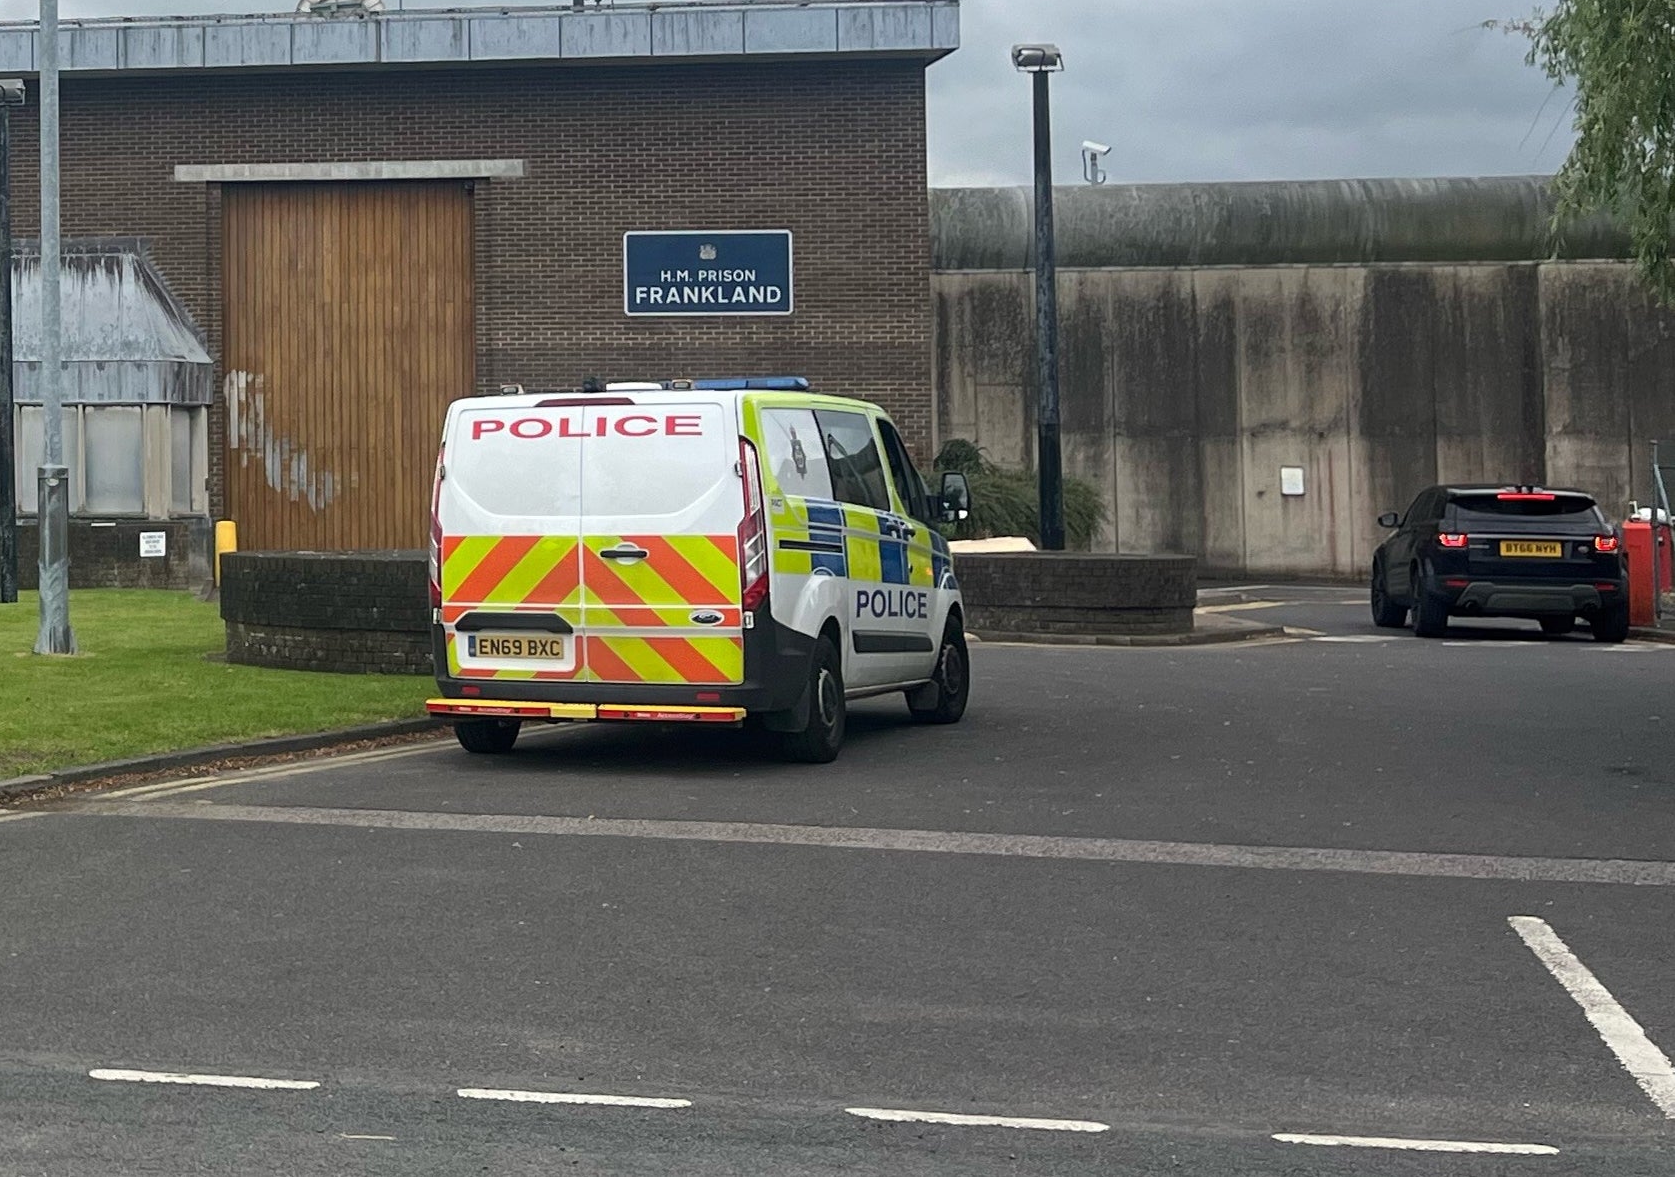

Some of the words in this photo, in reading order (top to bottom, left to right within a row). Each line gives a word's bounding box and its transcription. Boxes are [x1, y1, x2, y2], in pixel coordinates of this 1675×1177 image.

[660, 270, 693, 283] H.M.
[698, 269, 756, 282] PRISON
[635, 286, 782, 304] FRANKLAND
[472, 415, 703, 440] POLICE
[856, 589, 928, 619] POLICE
[479, 639, 522, 655] EN69
[527, 640, 560, 656] BXC
